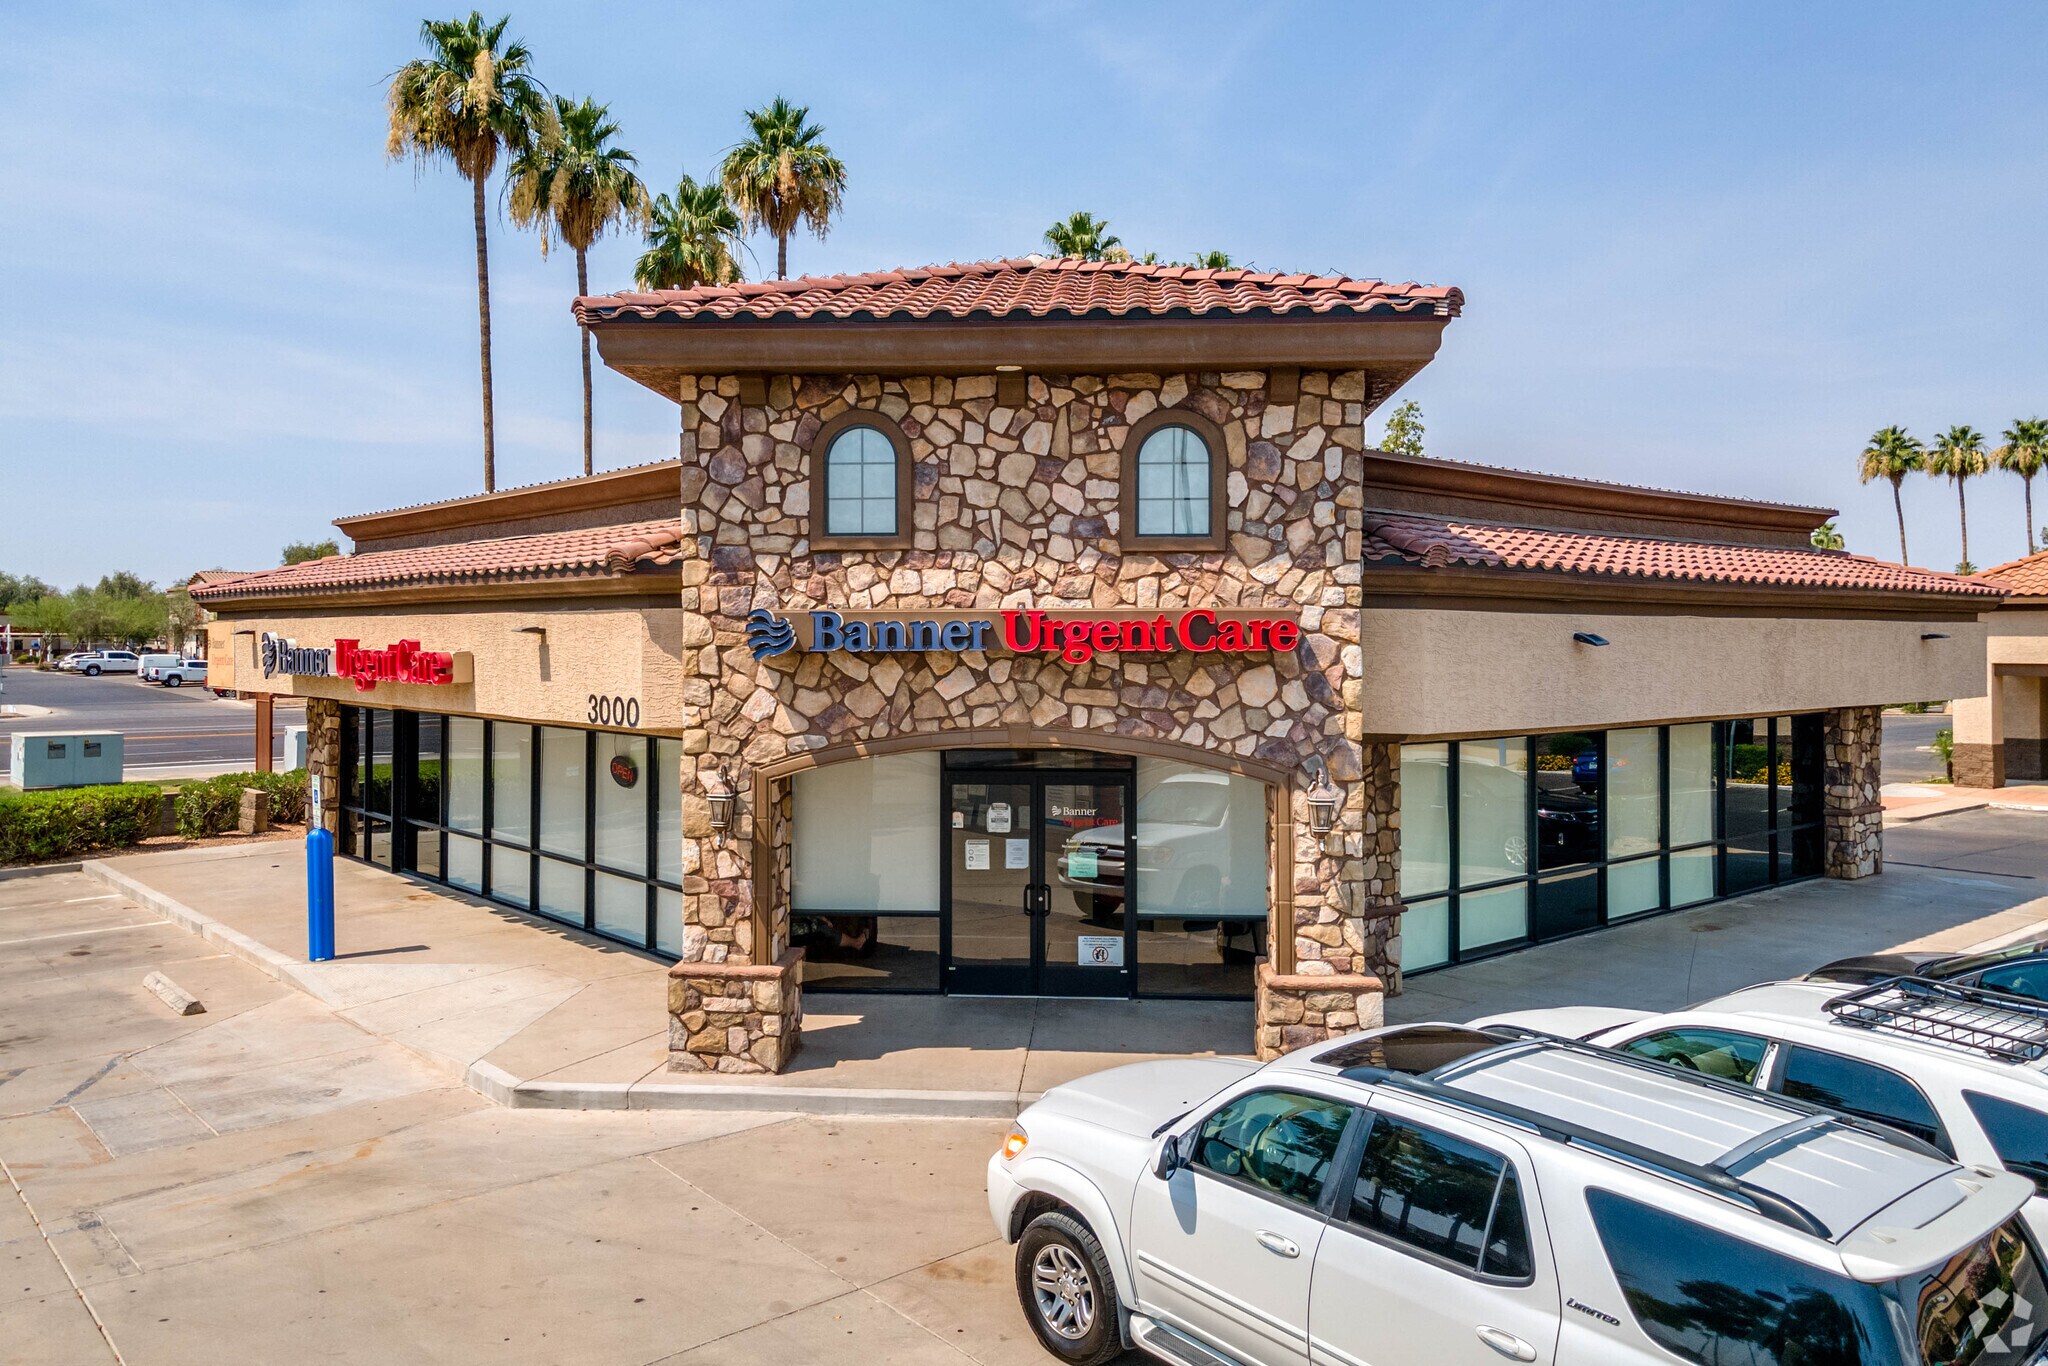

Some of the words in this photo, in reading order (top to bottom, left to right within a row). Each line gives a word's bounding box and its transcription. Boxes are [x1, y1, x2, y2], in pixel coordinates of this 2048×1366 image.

[808, 611, 992, 652] Banner
[1001, 609, 1172, 665] Urgent
[1178, 609, 1299, 653] Care
[278, 638, 331, 677] Banner
[335, 638, 398, 692] Urgent
[397, 639, 453, 686] Care
[588, 694, 640, 728] 3000
[611, 762, 633, 782] OPEN
[1062, 806, 1097, 816] Banner
[1062, 816, 1095, 829] Urgent
[1096, 817, 1119, 827] Care
[1566, 1297, 1621, 1327] LIMITED
